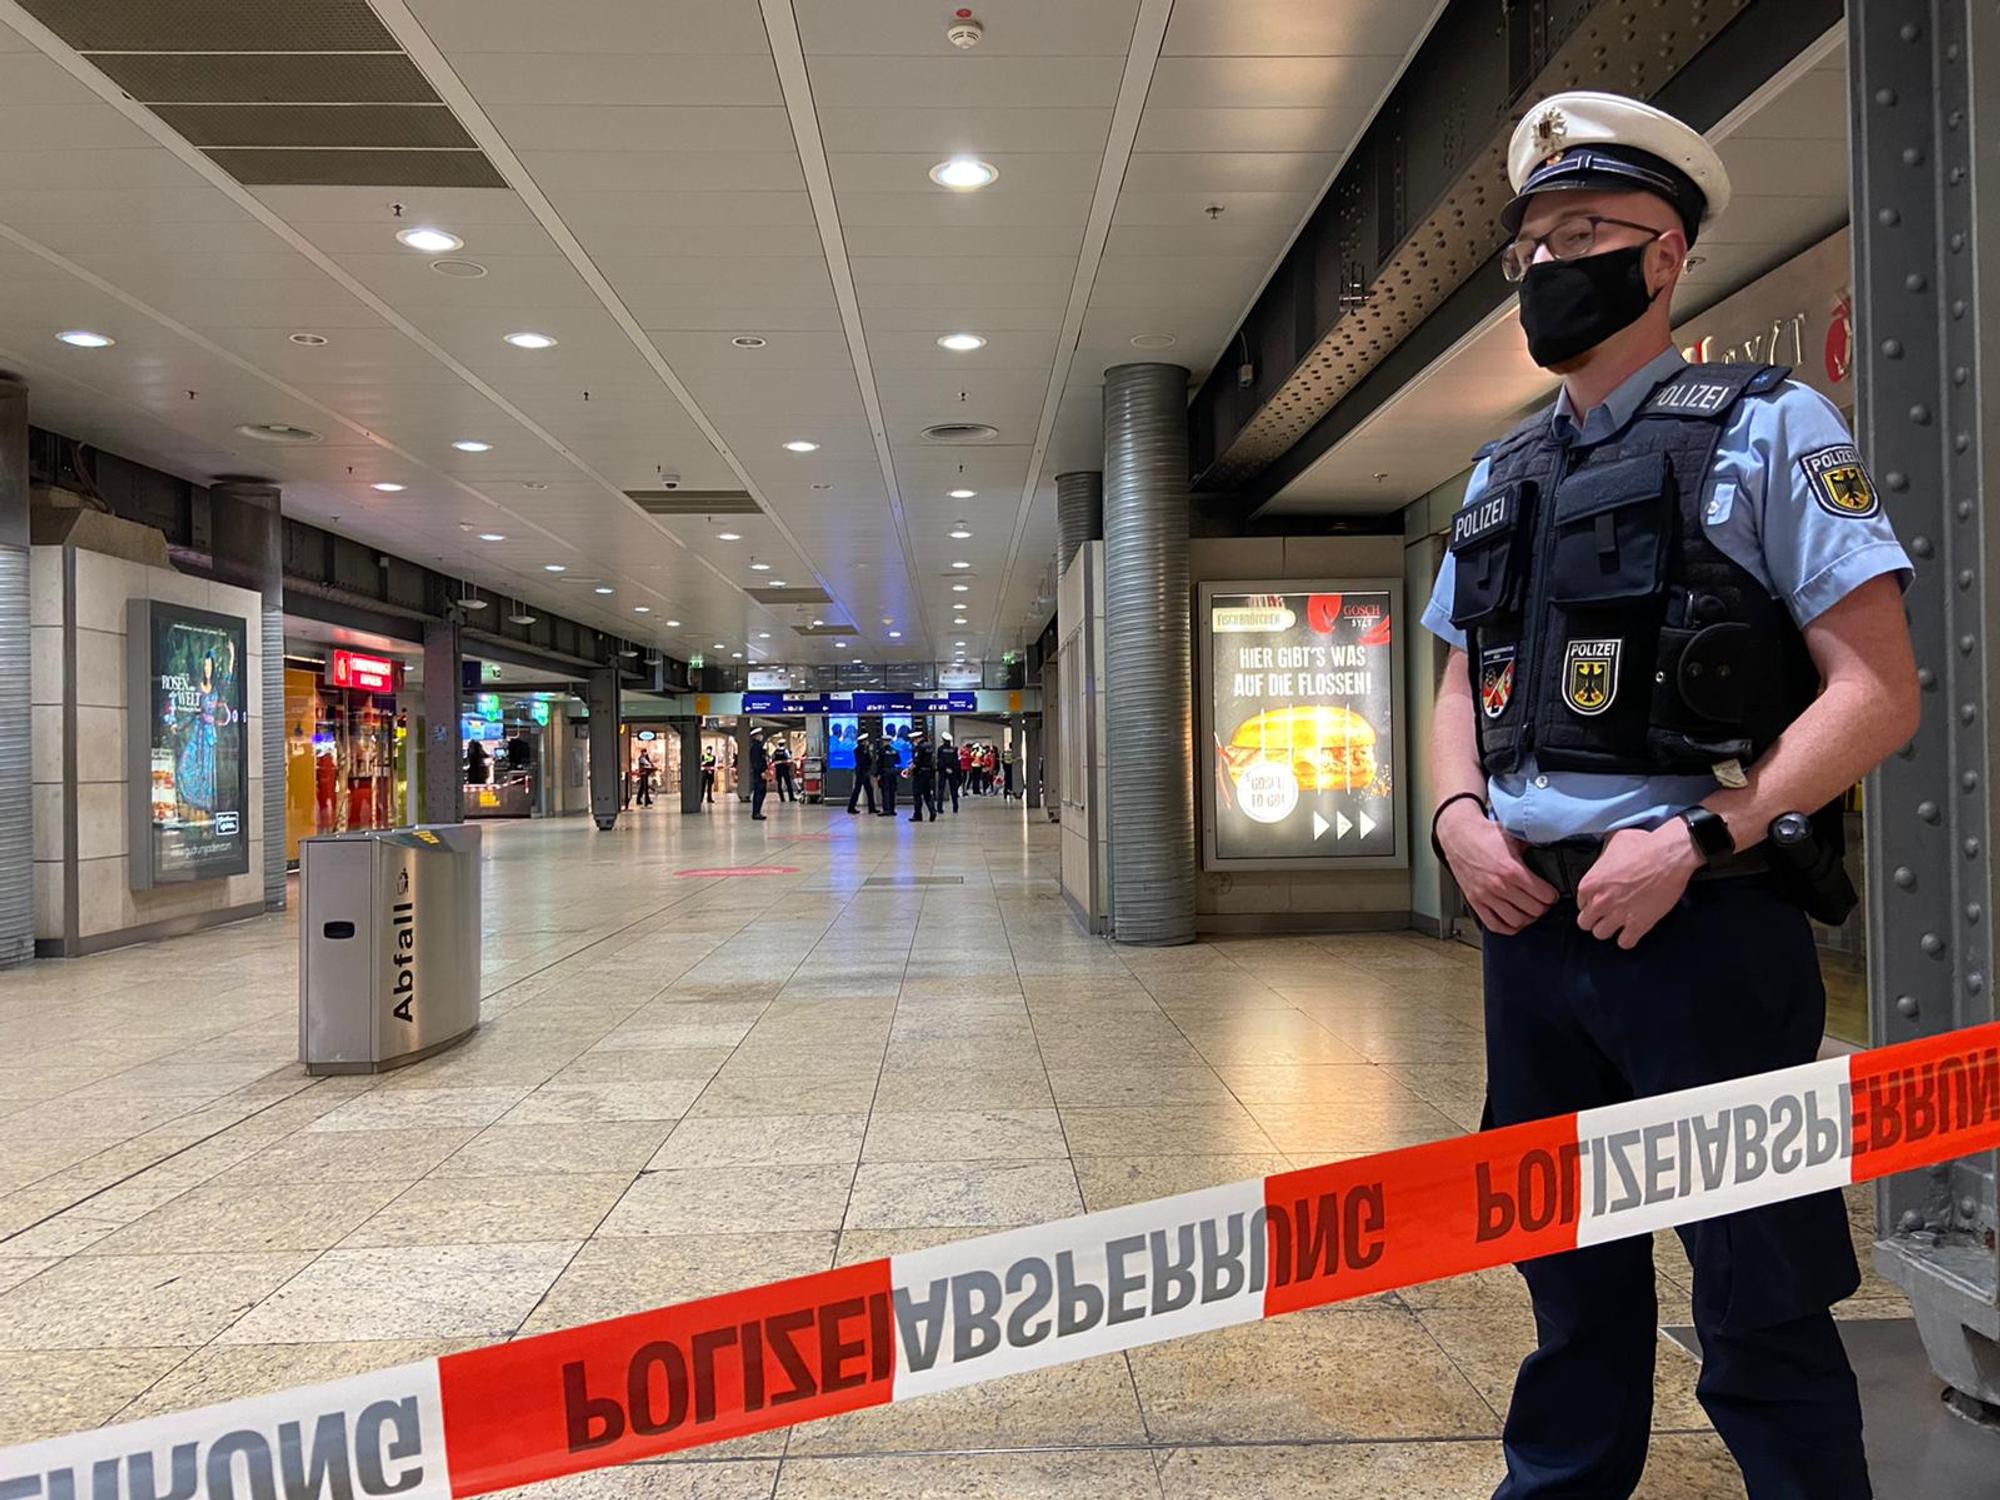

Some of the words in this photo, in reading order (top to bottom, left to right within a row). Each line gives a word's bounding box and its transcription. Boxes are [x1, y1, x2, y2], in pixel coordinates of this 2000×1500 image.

[1455, 496, 1505, 542] POLIZEI
[1343, 605, 1381, 616] GOSCH
[1240, 647, 1273, 669] HIER
[1330, 645, 1366, 667] WAS
[1571, 643, 1615, 656] POLIZEI
[1233, 673, 1265, 697] AUF
[1268, 673, 1293, 696] DIE
[1297, 671, 1372, 696] FLOSSEN!
[177, 692, 201, 706] WELT
[393, 902, 413, 1022] Abfall
